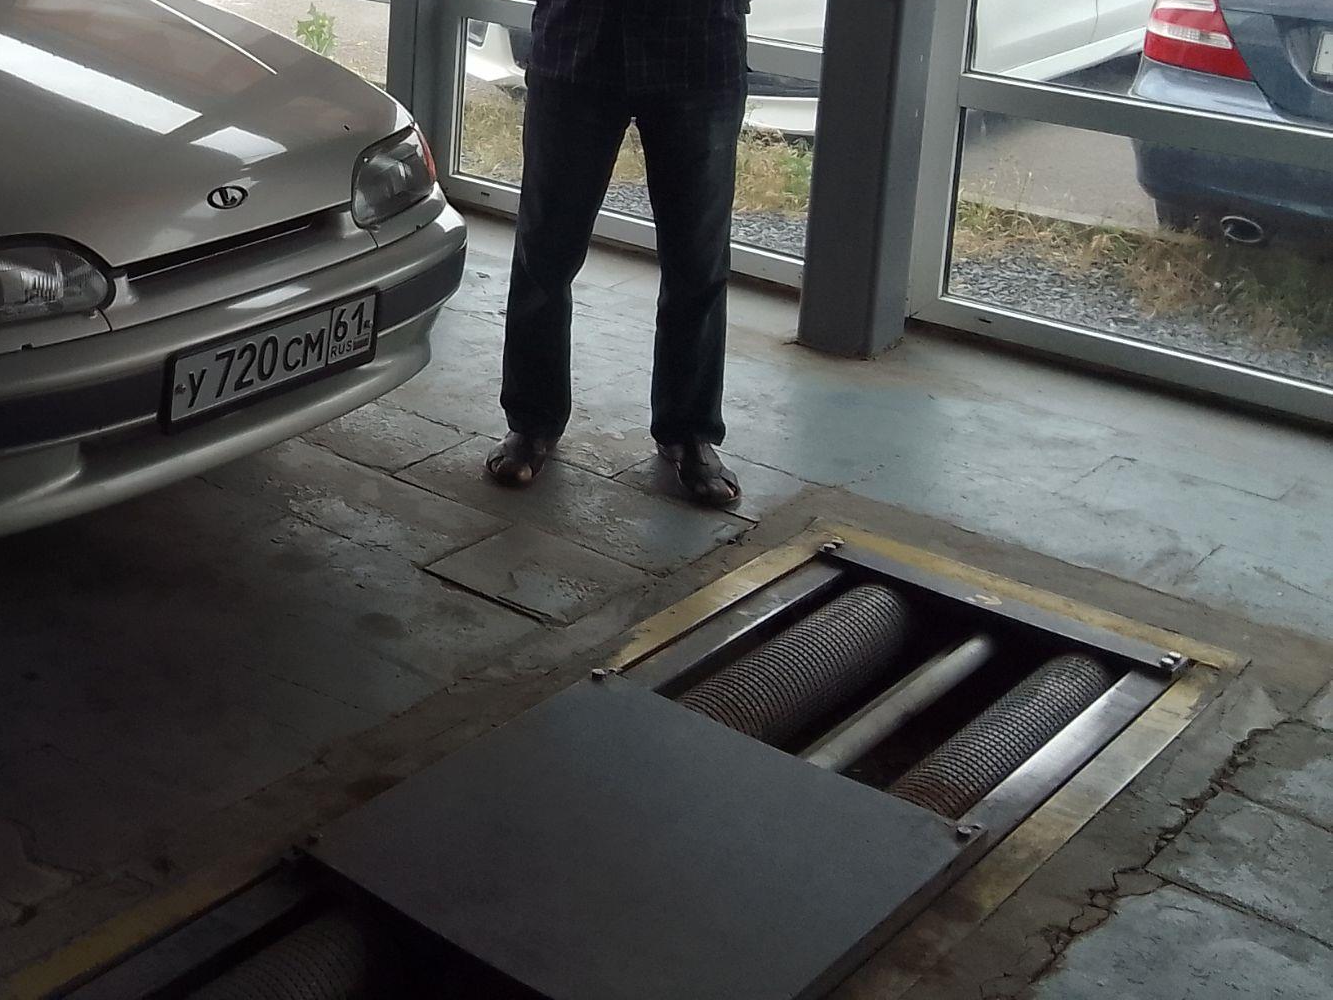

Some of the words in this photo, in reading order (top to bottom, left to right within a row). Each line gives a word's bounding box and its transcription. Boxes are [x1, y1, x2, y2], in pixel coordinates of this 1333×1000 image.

[187, 328, 326, 409] У720СМ
[332, 302, 365, 342] 61
[329, 341, 353, 359] RUS
